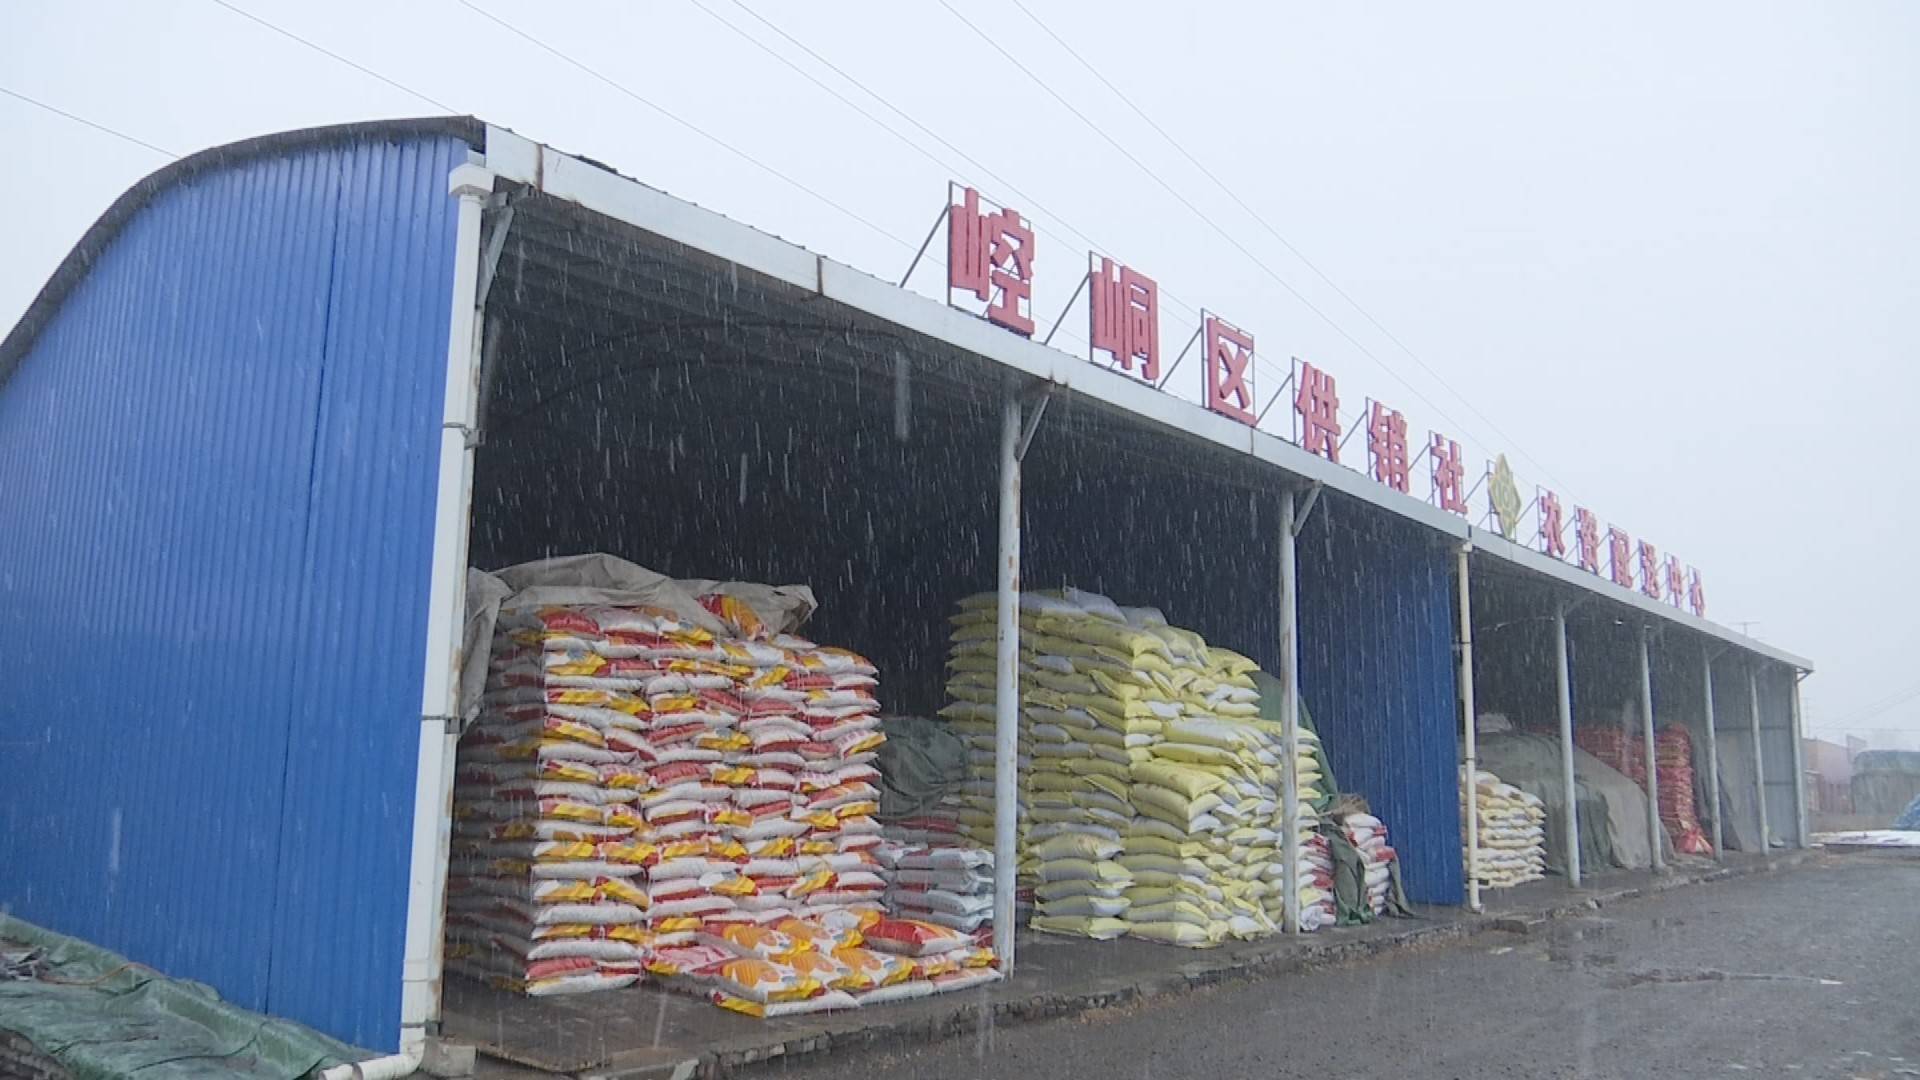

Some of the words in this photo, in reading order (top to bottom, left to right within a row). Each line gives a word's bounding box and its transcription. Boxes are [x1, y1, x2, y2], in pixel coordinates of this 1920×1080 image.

[951, 187, 1467, 513] 崆峒区供销社
[1541, 491, 1705, 617] 农资配送中心
